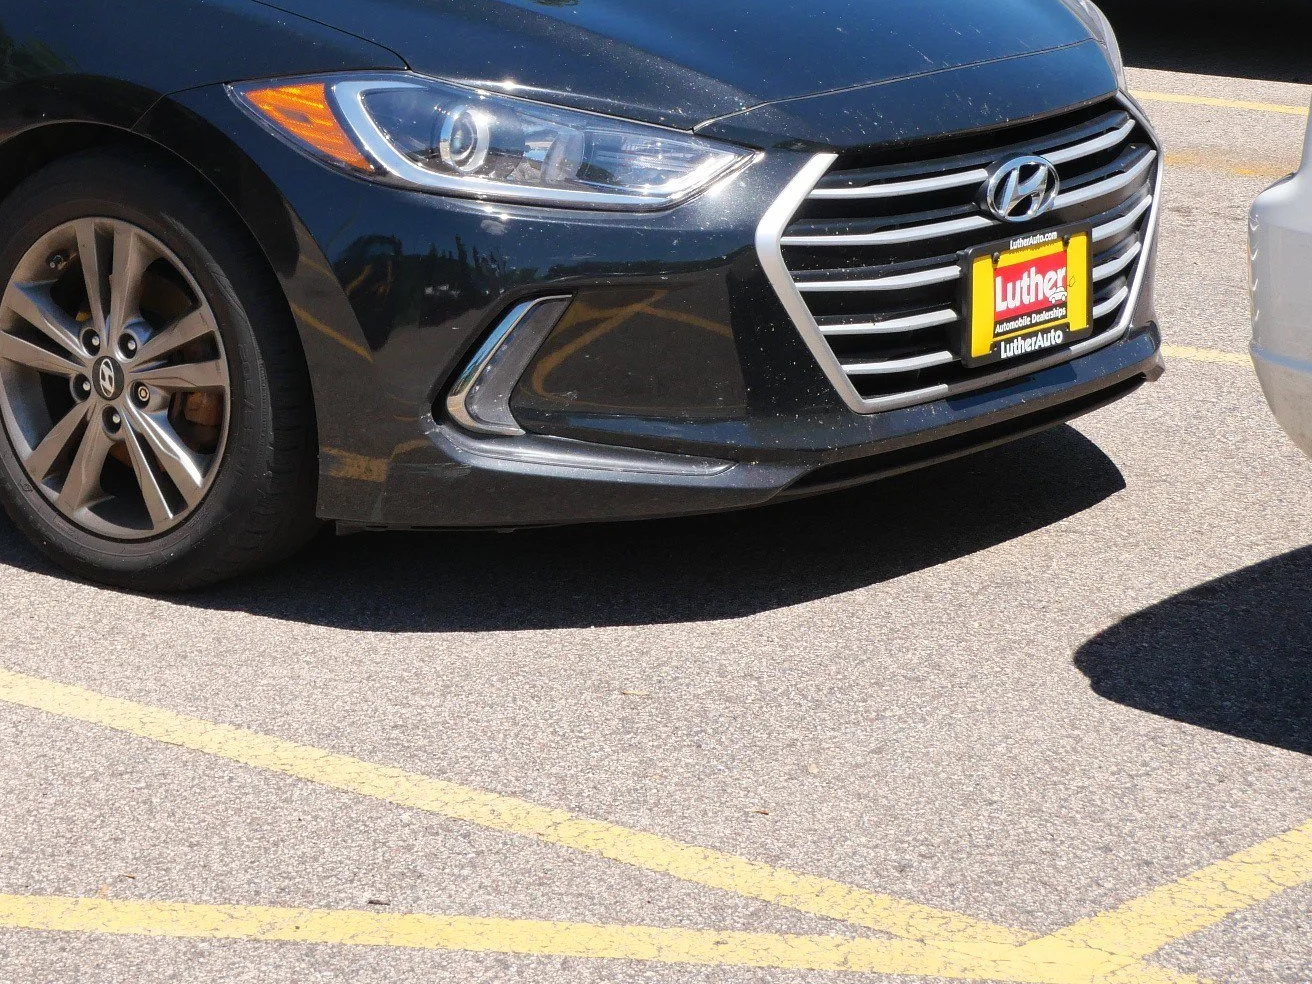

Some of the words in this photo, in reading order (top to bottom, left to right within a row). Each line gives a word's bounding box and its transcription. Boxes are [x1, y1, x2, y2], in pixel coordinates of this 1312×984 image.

[1009, 231, 1058, 250] LutherAuto.com
[995, 266, 1067, 312] Luther
[995, 316, 1031, 334] Automobile
[1032, 307, 1066, 324] Dealerships
[1000, 329, 1063, 359] LutherAuto
